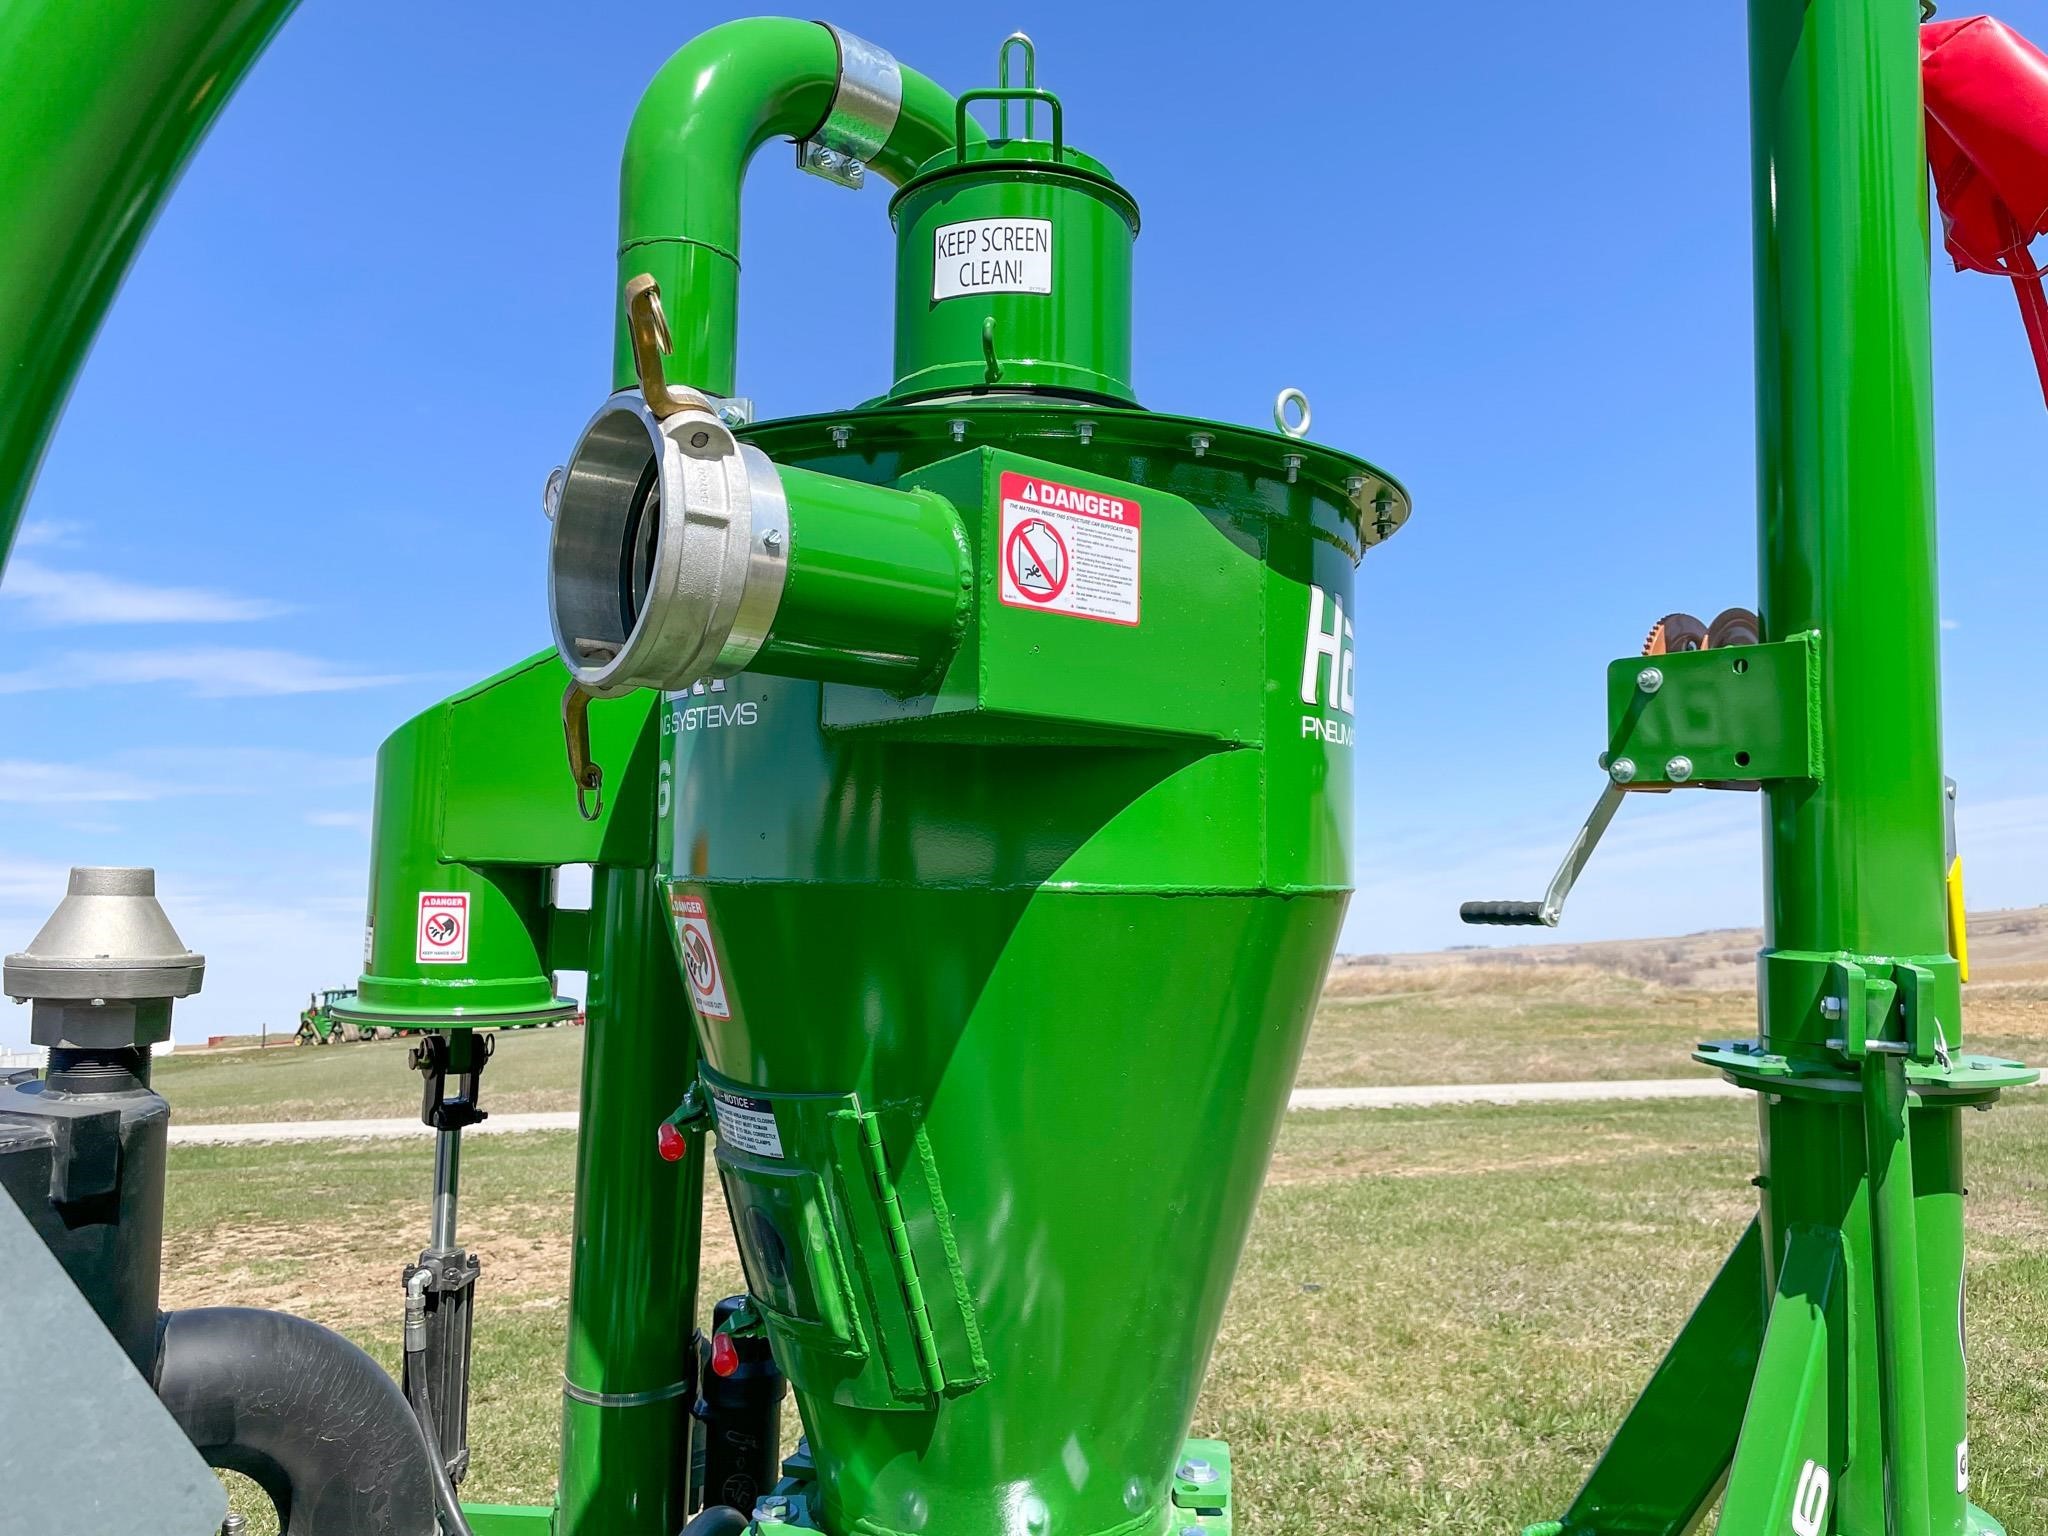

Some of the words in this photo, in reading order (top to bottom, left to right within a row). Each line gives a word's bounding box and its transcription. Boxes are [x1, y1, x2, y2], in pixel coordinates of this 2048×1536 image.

[938, 229, 976, 259] KEEP
[982, 226, 1047, 253] SCREEN
[959, 259, 1022, 287] CLEAN!
[1041, 484, 1123, 520] DANGER
[672, 702, 757, 733] SYSTEMS
[430, 898, 463, 906] DANGER
